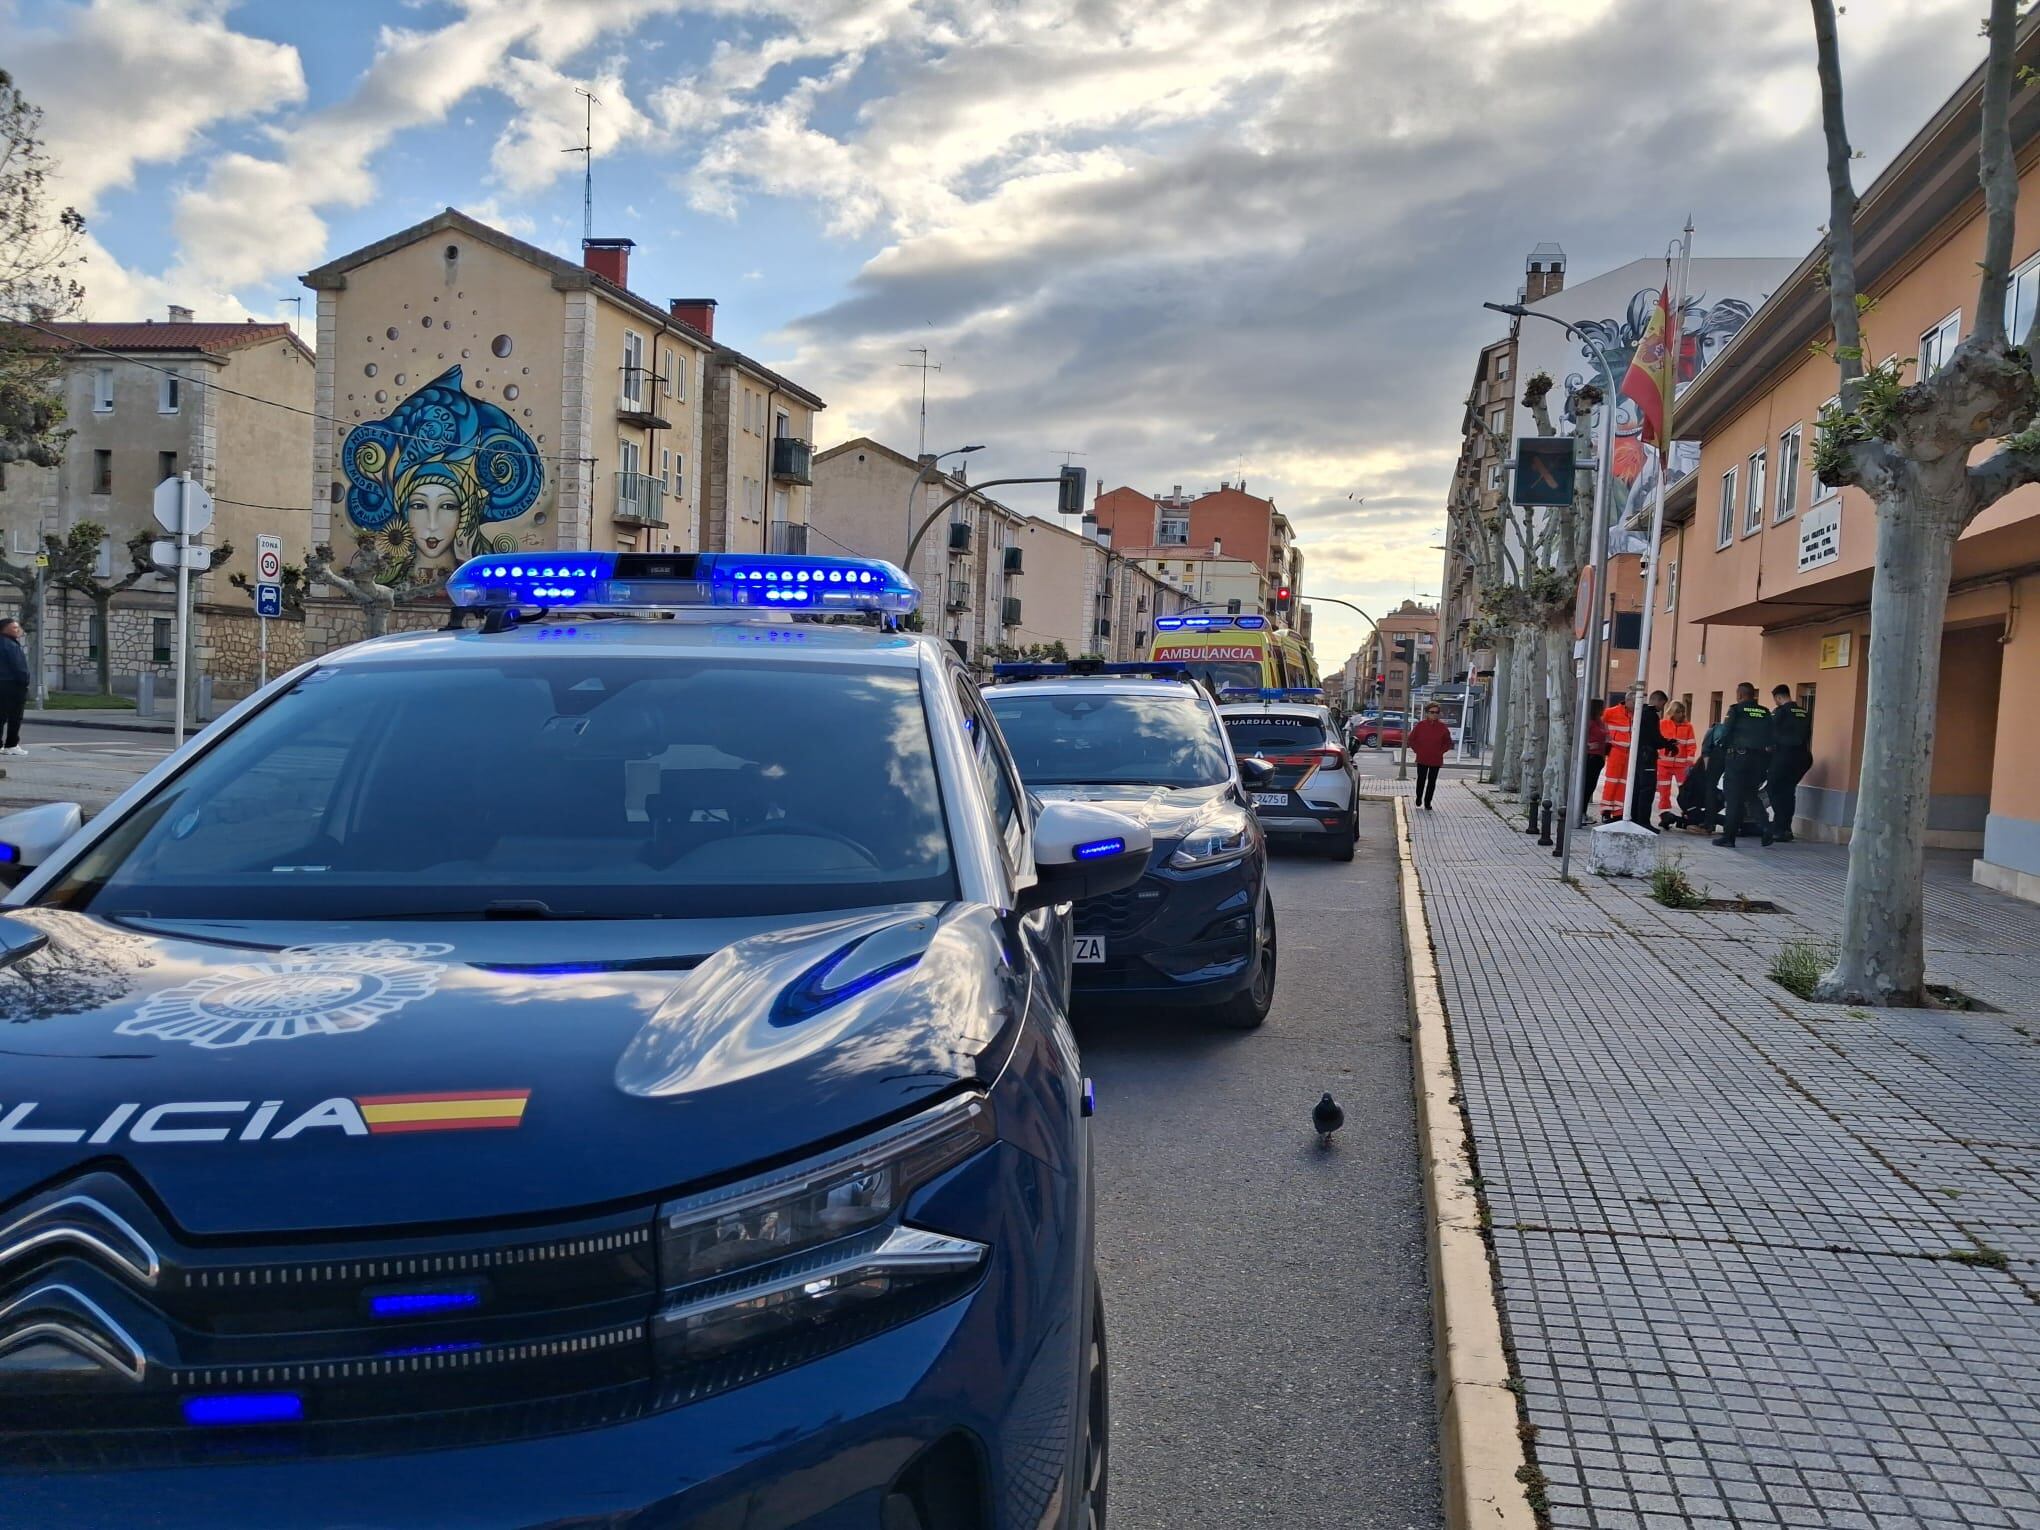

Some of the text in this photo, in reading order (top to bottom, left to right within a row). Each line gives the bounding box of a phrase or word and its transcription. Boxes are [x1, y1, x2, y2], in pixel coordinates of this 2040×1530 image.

[262, 541, 278, 549] ZONA
[264, 560, 275, 569] 30
[1160, 648, 1254, 660] AMBULANCIA
[1275, 719, 1302, 727] CIVIL
[1073, 939, 1101, 959] ZA
[0, 1097, 369, 1143] LICIA
